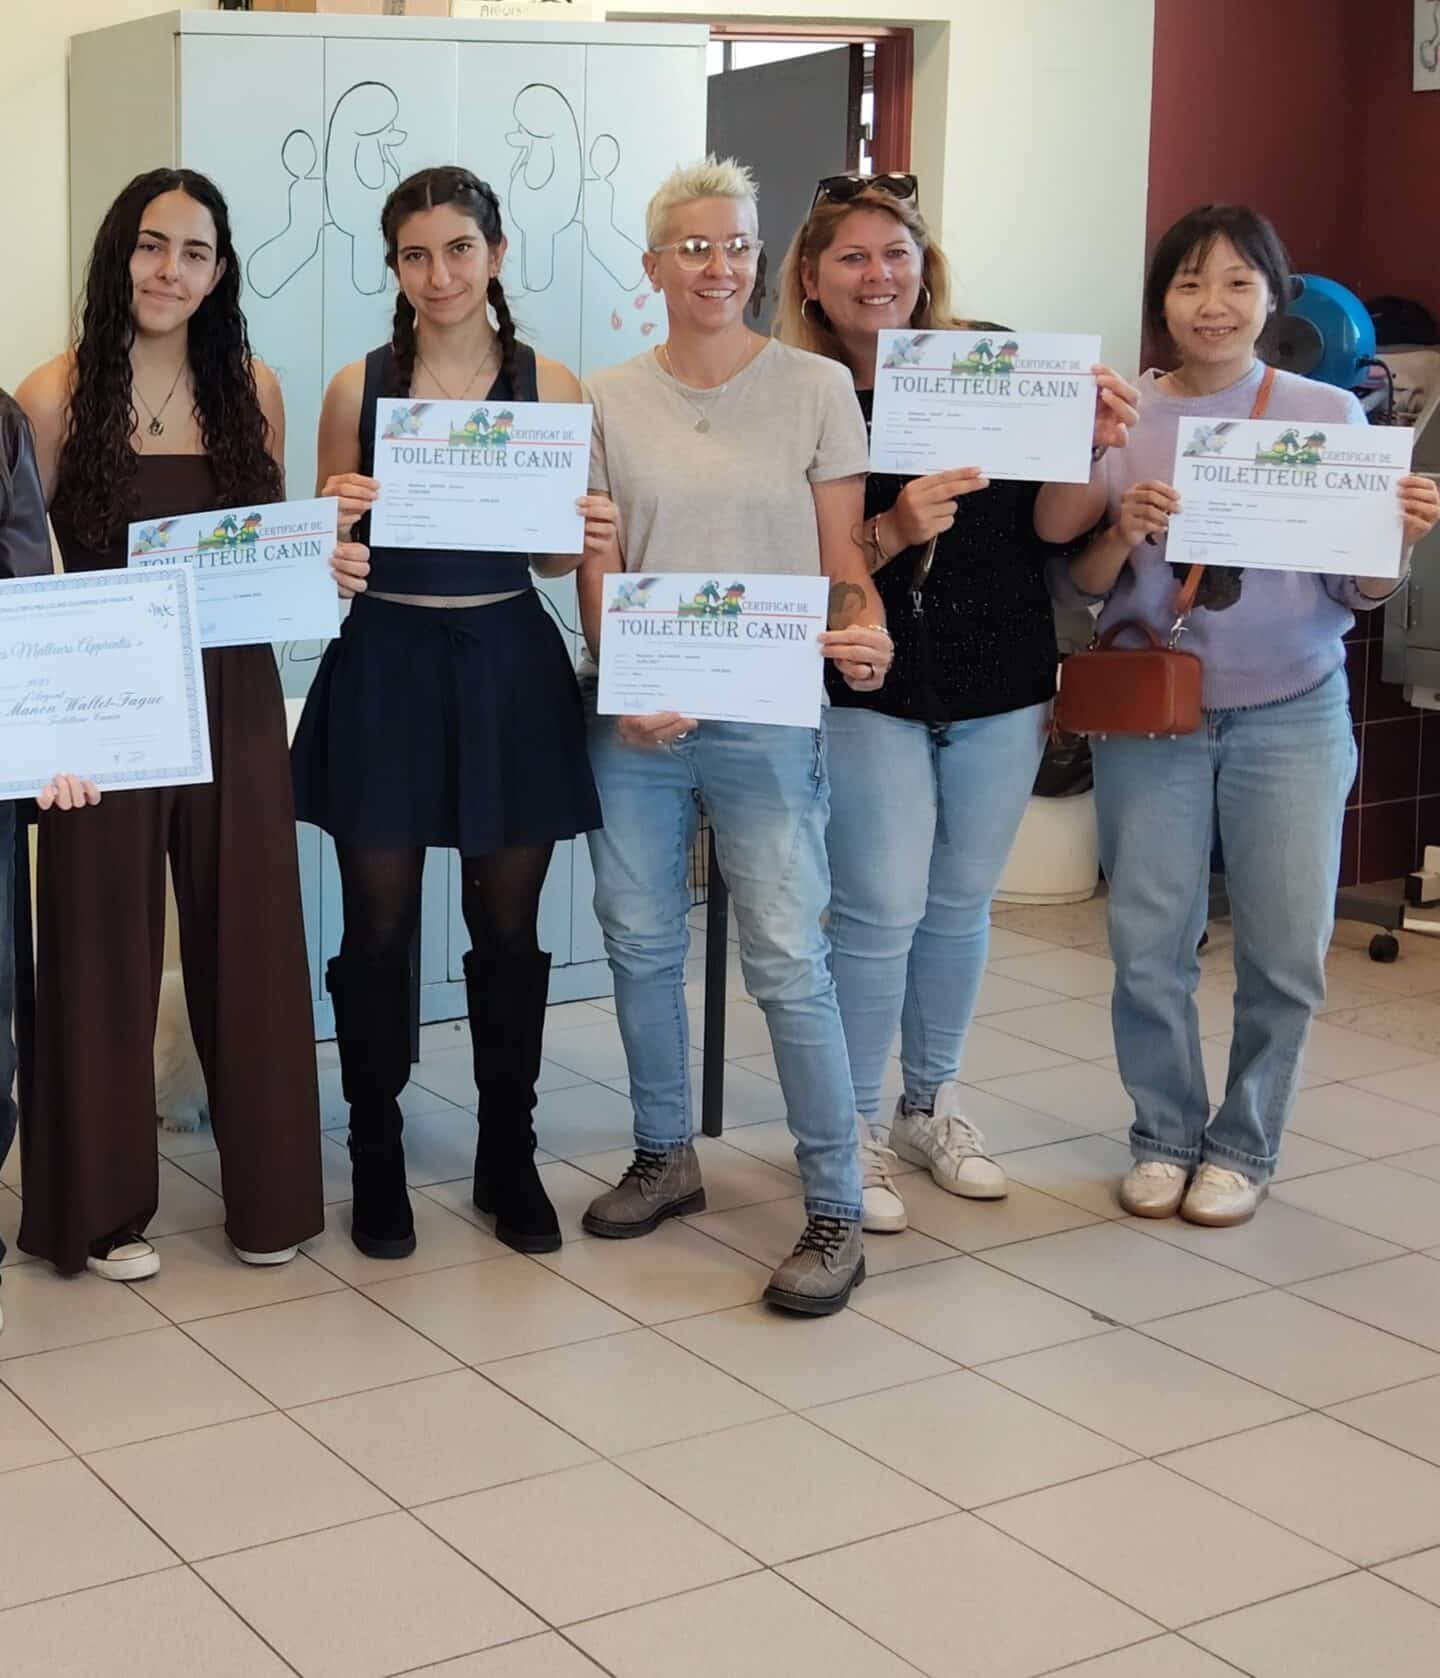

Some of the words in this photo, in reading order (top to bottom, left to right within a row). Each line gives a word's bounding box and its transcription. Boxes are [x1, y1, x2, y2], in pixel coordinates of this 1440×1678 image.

[1015, 359, 1068, 370] CERTIFICAT
[1069, 360, 1081, 370] DE
[891, 375, 1012, 397] TOILETTEUR
[1017, 379, 1080, 399] CANIN
[509, 429, 561, 440] CERTIFICAT
[562, 431, 574, 441] DE
[391, 446, 508, 468] TOILETTEUR
[513, 450, 573, 469] CANIN
[1321, 450, 1378, 463] CERTIFICAT
[1379, 453, 1393, 464] DE
[1191, 464, 1318, 489] TOILETTEUR
[1325, 471, 1392, 492] CANIN
[258, 522, 309, 537] CERTIFICAT
[263, 540, 323, 562] CANIN
[741, 600, 796, 613] CERTIFICAT
[797, 603, 809, 613] DE
[617, 619, 739, 639] TOILETTEUR
[746, 621, 809, 641] CANIN
